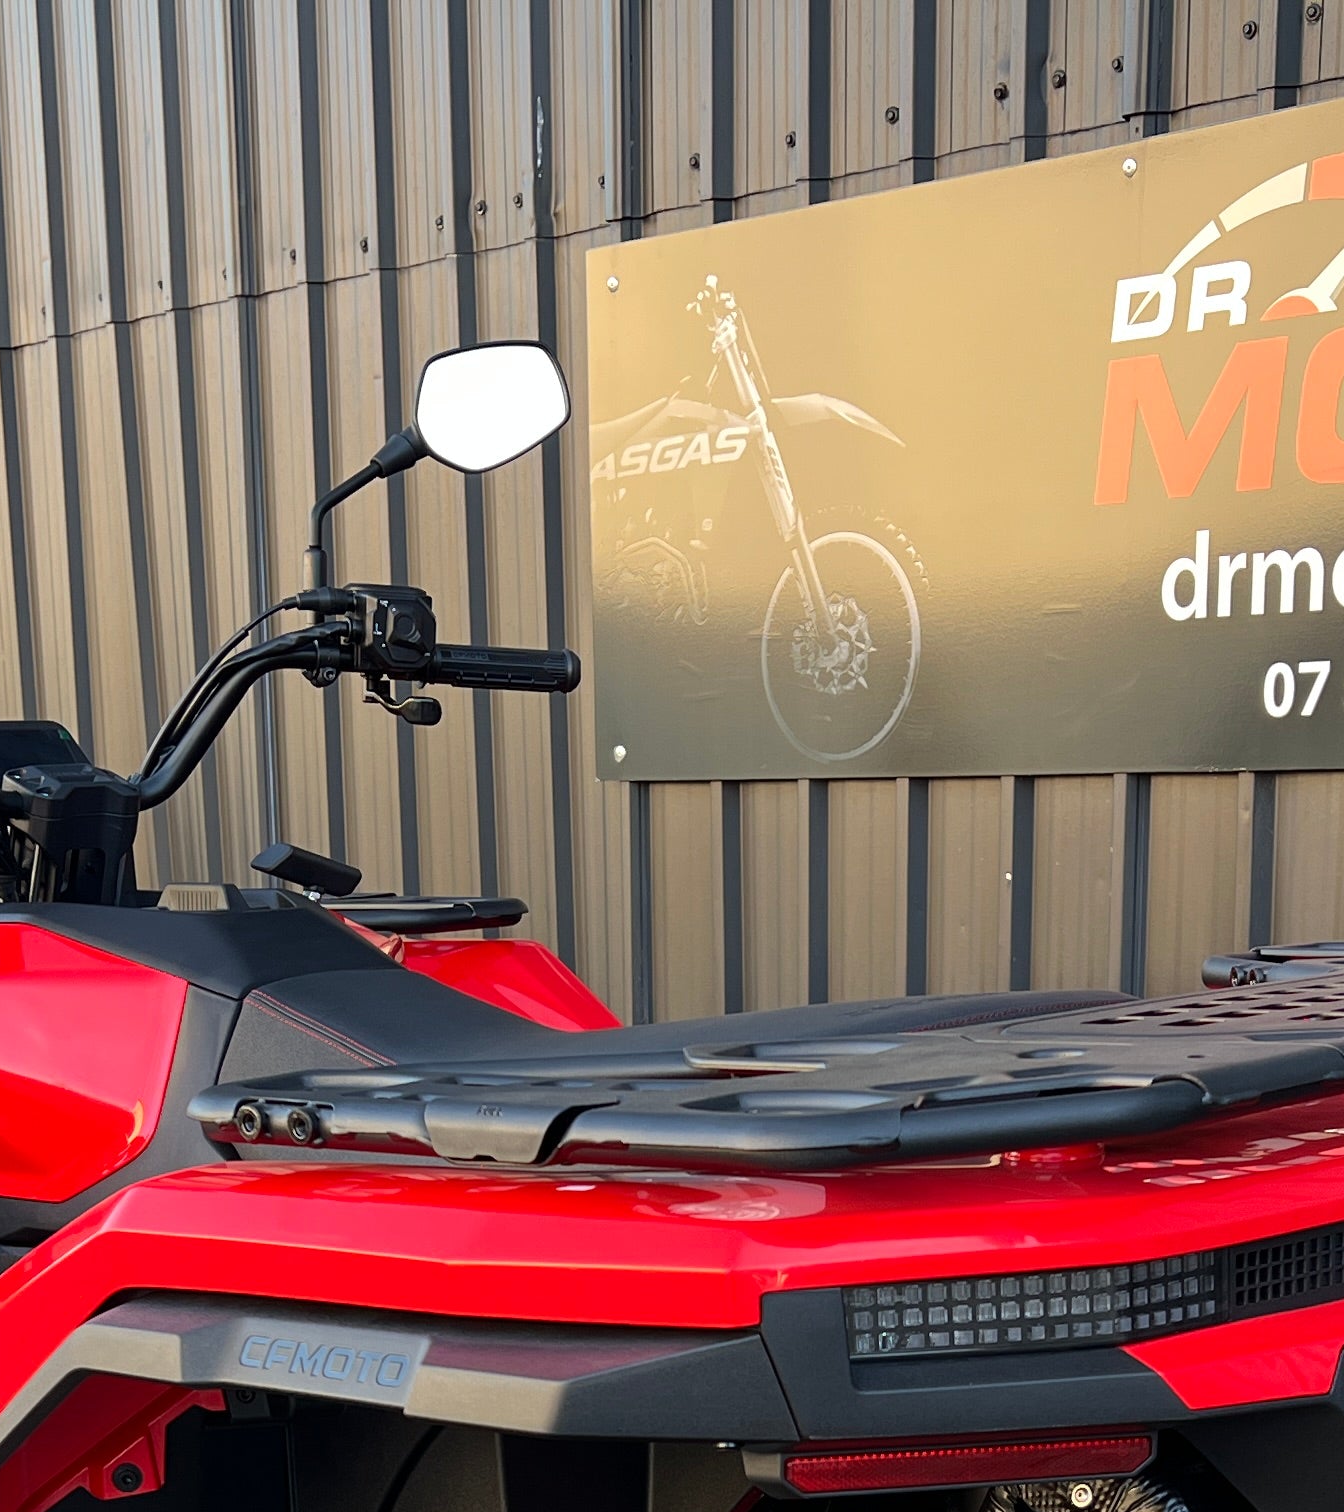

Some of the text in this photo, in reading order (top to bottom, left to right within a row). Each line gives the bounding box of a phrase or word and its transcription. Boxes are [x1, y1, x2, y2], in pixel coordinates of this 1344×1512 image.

[1110, 261, 1252, 342] DR
[592, 427, 749, 480] ASGAS
[1263, 661, 1331, 718] 07
[238, 1335, 412, 1388] CFMOTO
